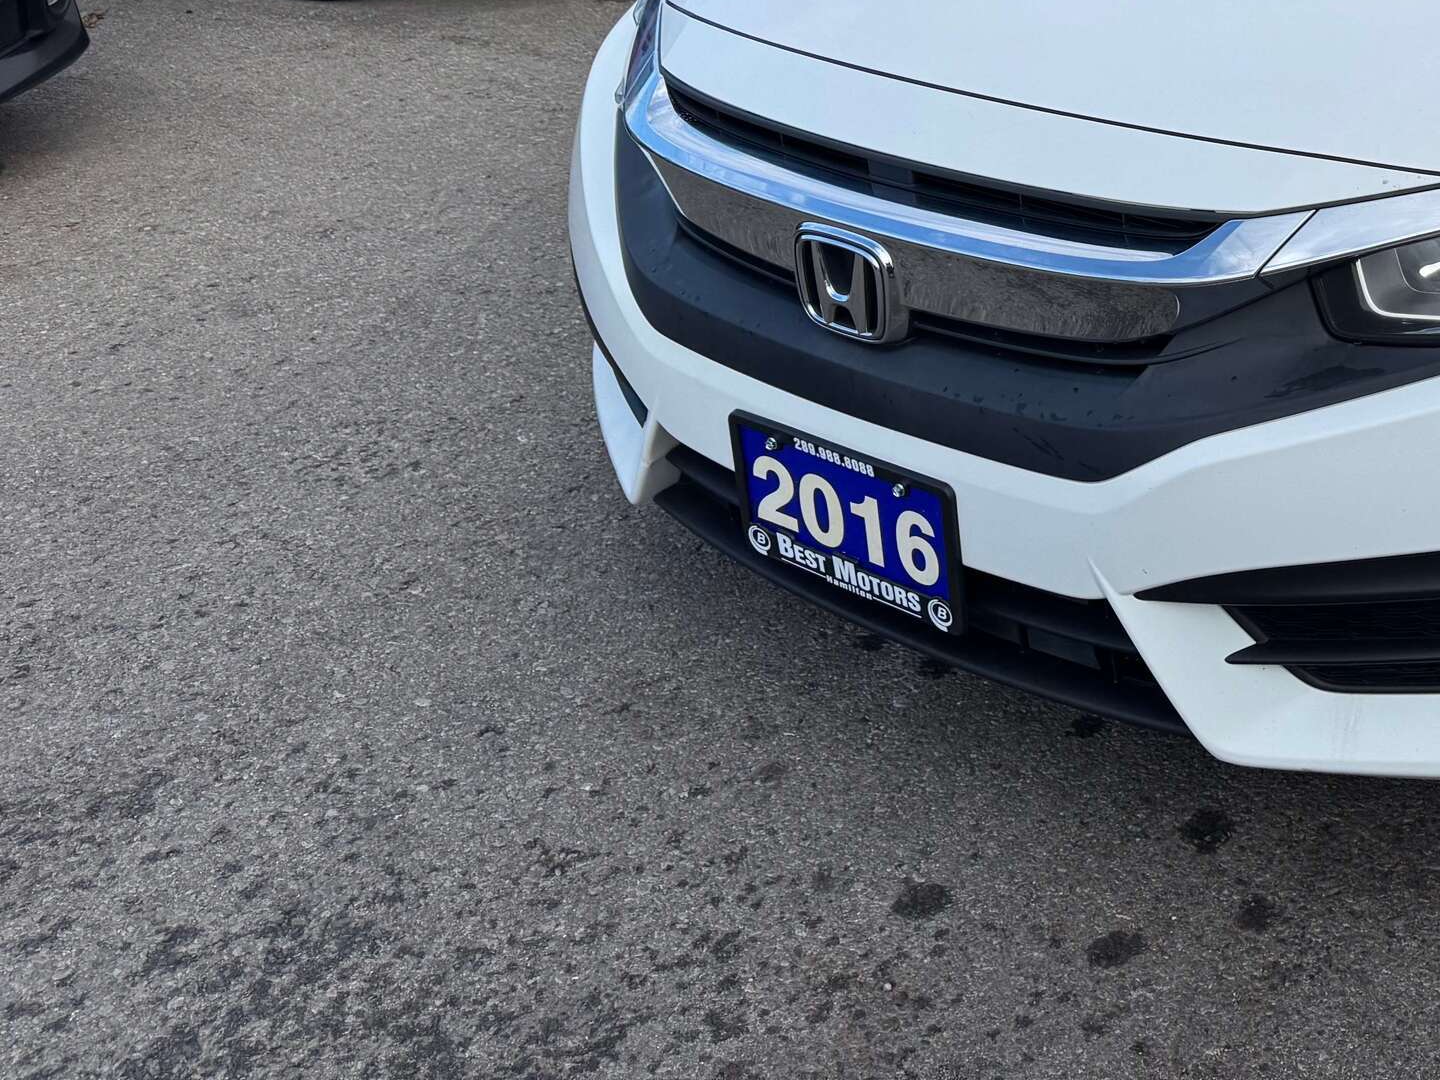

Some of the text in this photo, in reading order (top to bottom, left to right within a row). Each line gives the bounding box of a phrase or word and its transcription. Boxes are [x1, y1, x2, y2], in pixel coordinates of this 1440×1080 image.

[793, 437, 875, 478] 289.988.8088
[752, 455, 940, 586] 2016
[776, 532, 922, 613] BEST MOTORS
[825, 574, 874, 600] Hamilton
